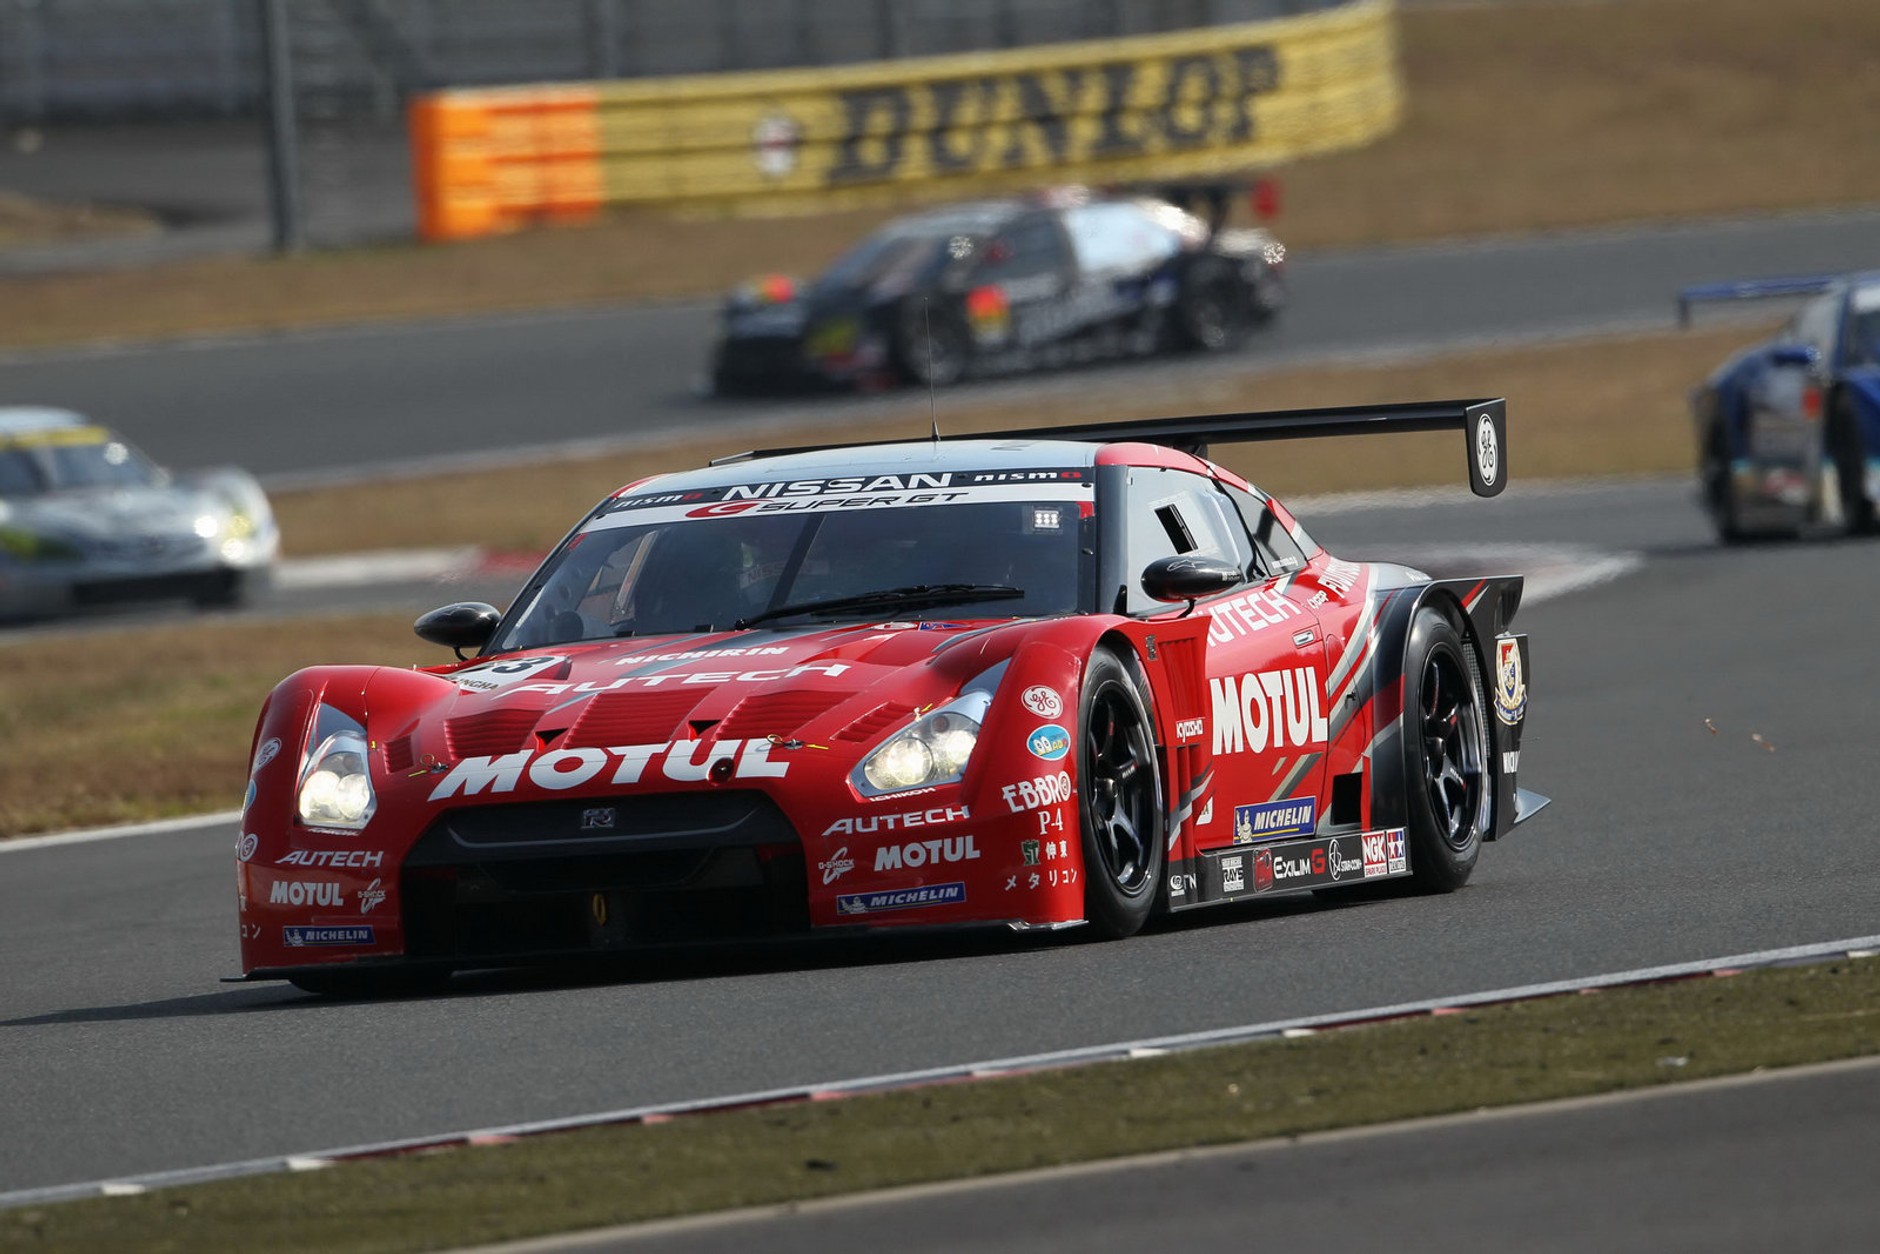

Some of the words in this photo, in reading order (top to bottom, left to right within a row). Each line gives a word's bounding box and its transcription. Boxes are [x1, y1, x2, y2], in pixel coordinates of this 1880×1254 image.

[828, 44, 1285, 184] DUNLOP
[720, 473, 953, 501] NISSAN
[974, 470, 1083, 483] nismo
[755, 495, 903, 513] SUPER
[904, 491, 971, 504] GT
[615, 646, 790, 668] NICHIRIN
[491, 664, 852, 700] AUTECH
[1210, 666, 1329, 756] MOTUL
[427, 736, 792, 801] MOTUL
[1002, 770, 1072, 813] EBBRO
[821, 805, 972, 837] AUTECH
[1038, 808, 1064, 835] P-4
[1254, 804, 1312, 830] MICHELIN
[275, 851, 384, 868] AUTECH
[873, 835, 981, 872] MOTUL
[1362, 835, 1386, 864] NGK
[270, 881, 344, 906] MOTUL
[870, 887, 959, 906] MICHELIN
[305, 930, 368, 941] MICHELIN
